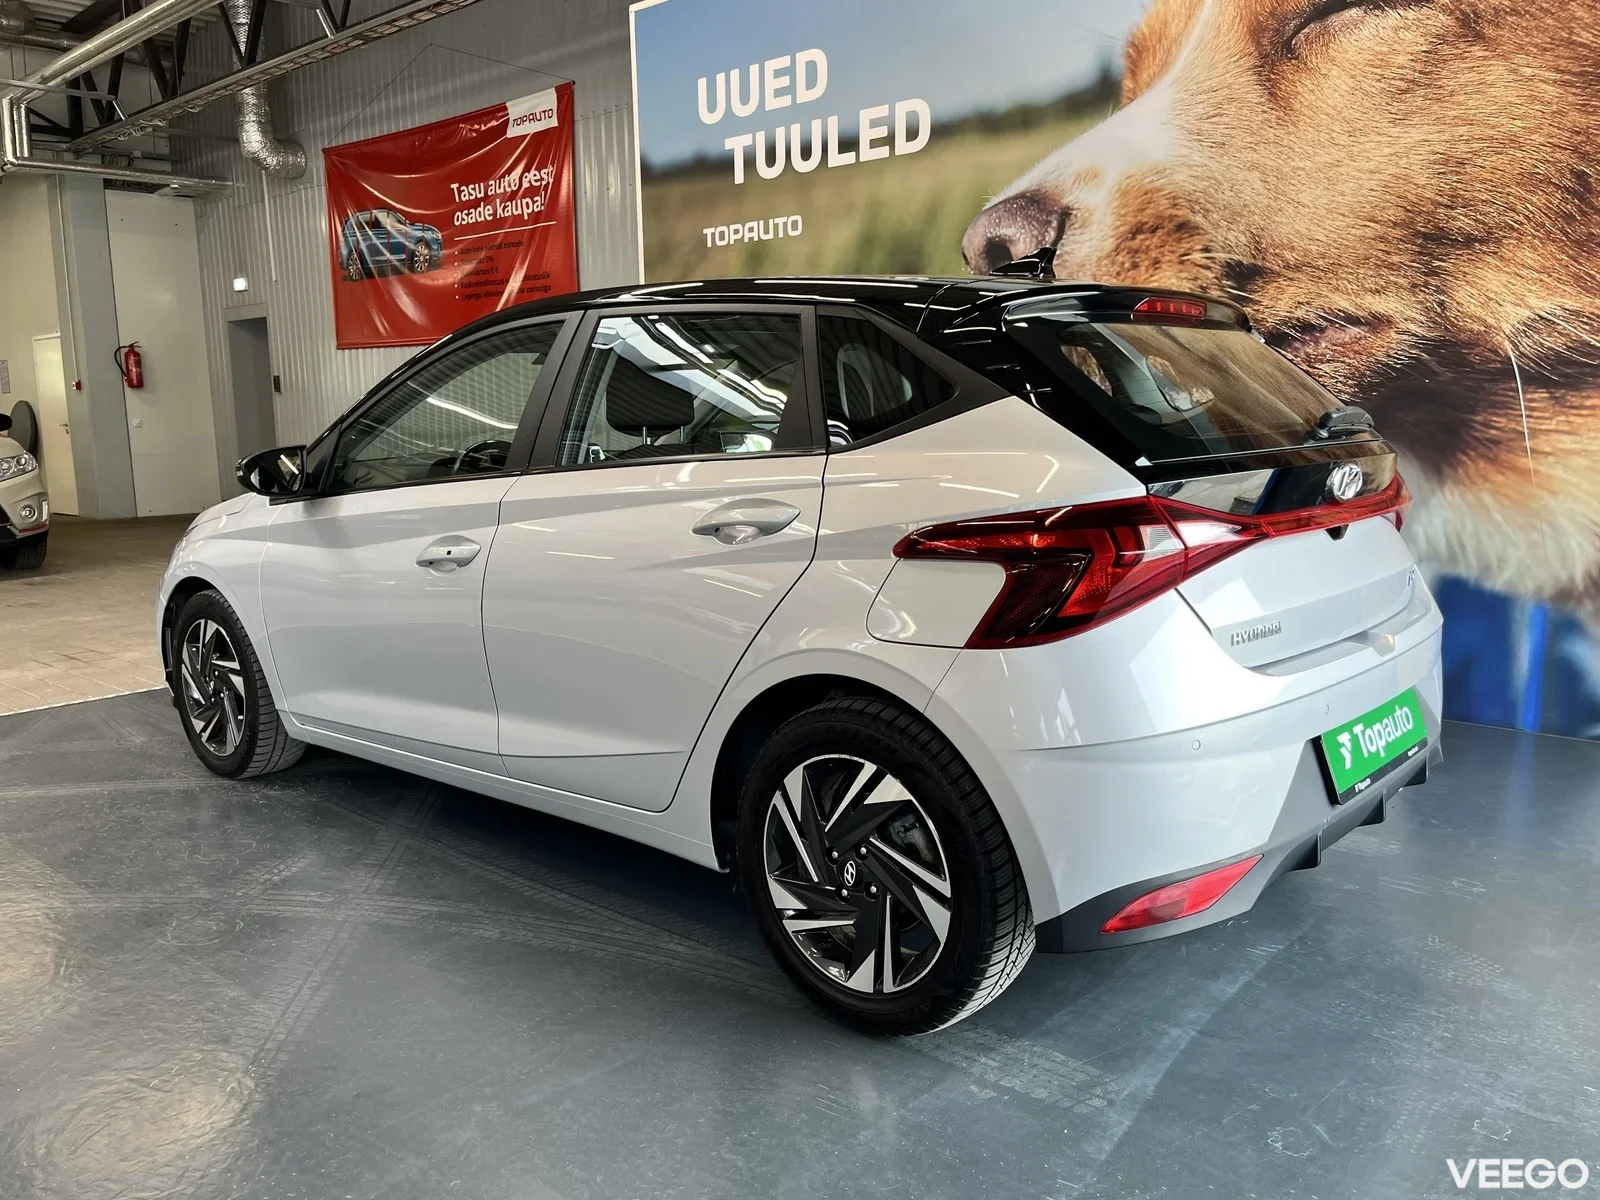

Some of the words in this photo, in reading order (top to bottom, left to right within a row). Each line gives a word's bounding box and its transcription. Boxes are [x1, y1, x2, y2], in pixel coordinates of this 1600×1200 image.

[697, 48, 828, 125] UUED
[512, 108, 554, 128] TOPAUTO
[724, 98, 931, 185] TUULED
[450, 183, 485, 203] Tasu
[487, 173, 520, 196] auto
[522, 165, 554, 188] eest
[453, 202, 493, 226] osade
[496, 191, 545, 220] kaupa!
[703, 214, 803, 248] TOPAUTO
[1352, 704, 1413, 758] Topauto
